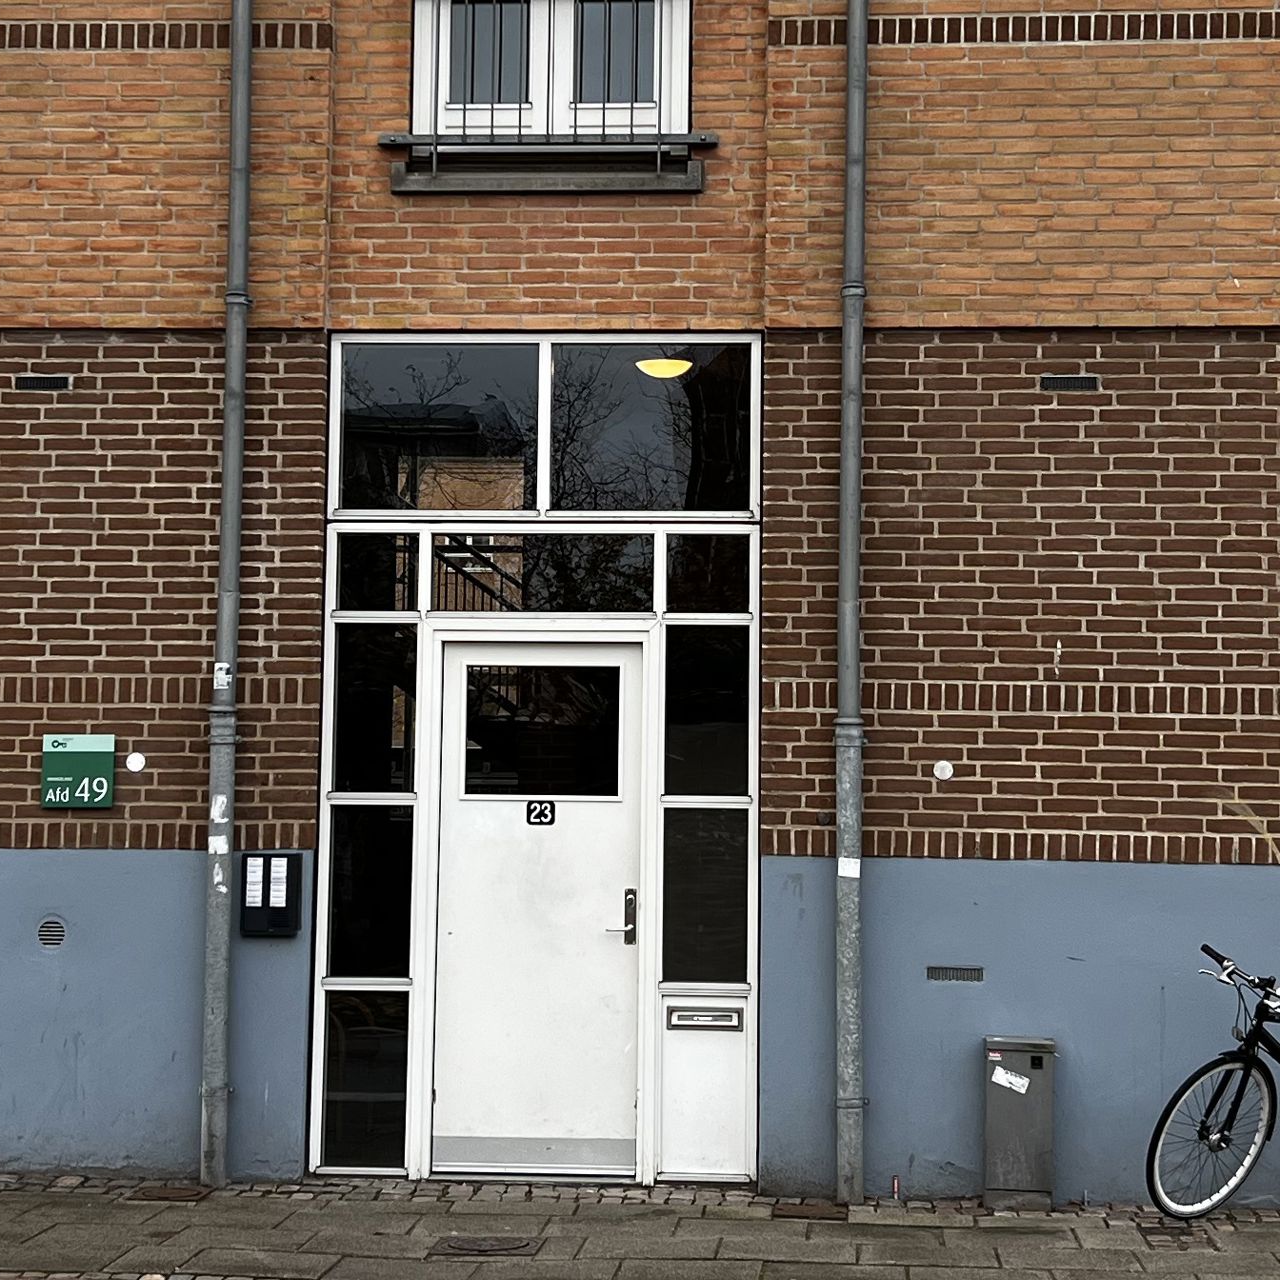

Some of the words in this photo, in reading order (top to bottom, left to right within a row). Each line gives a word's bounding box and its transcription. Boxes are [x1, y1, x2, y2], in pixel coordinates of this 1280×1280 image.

[45, 786, 70, 802] Afd
[74, 776, 108, 803] 49
[529, 802, 553, 823] 23
